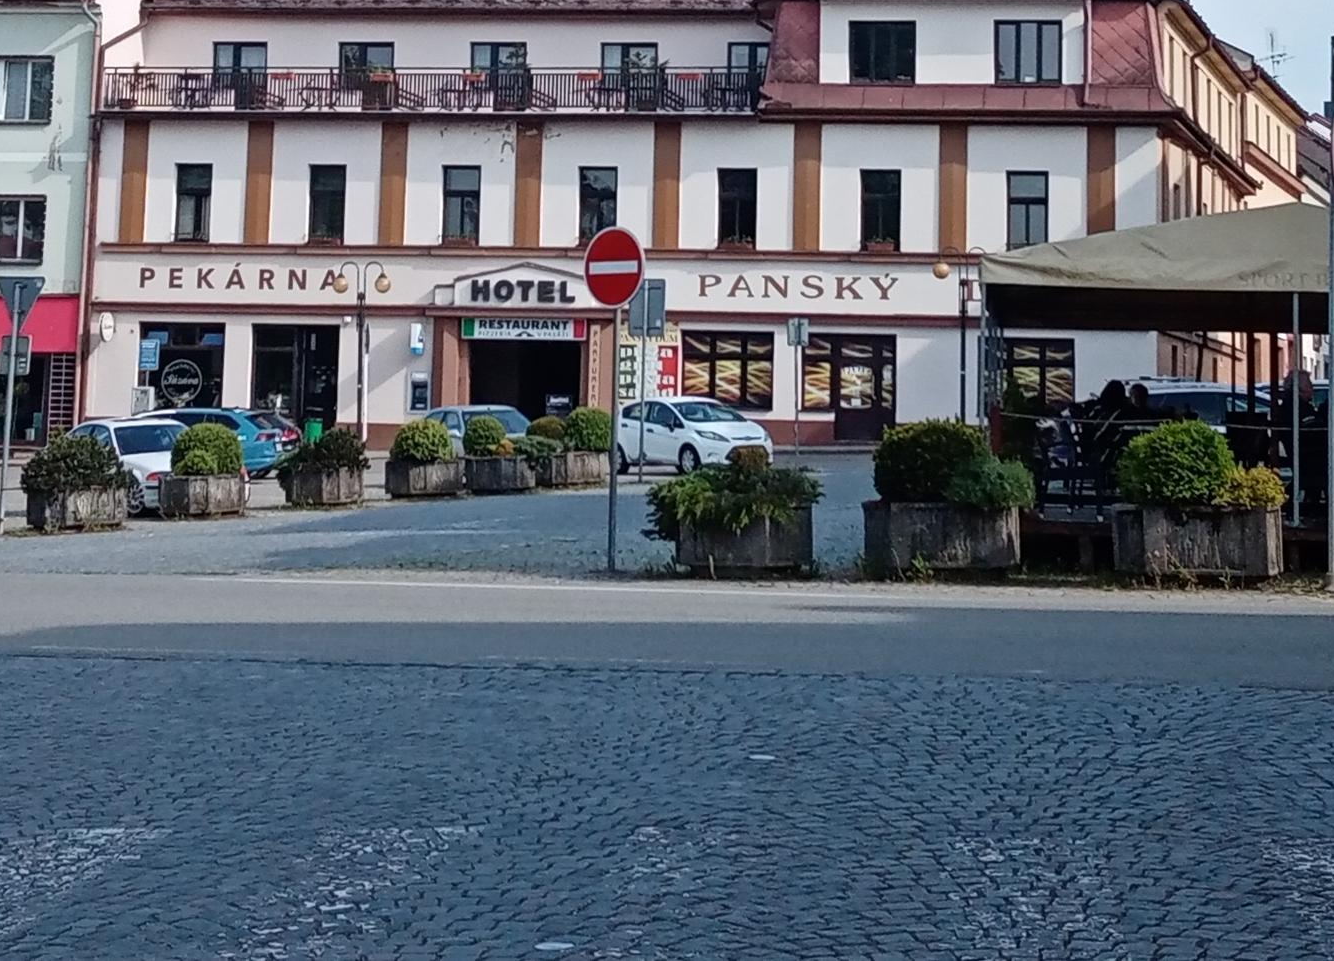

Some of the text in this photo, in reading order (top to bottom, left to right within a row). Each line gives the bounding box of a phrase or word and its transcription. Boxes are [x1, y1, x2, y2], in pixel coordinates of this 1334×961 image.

[138, 262, 337, 290] PEKÁRNA
[697, 272, 900, 301] PANSKÝ
[470, 279, 576, 304] HOTEL
[478, 319, 570, 331] RESTAURANT
